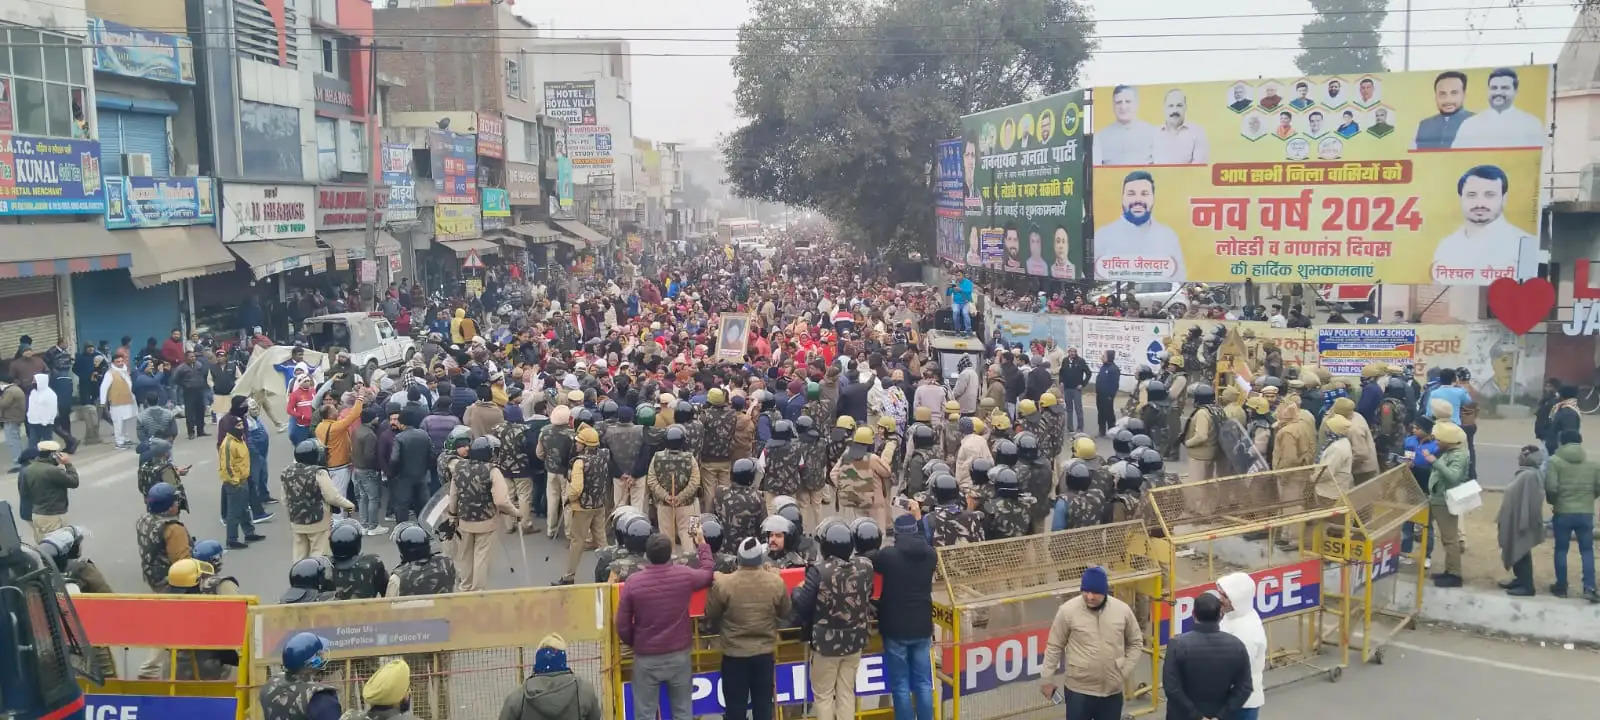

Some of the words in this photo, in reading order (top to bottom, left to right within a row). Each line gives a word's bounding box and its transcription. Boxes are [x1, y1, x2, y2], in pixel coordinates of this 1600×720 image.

[556, 89, 584, 98] HOTEL
[546, 99, 571, 108] ROYAL
[573, 99, 595, 108] VILLA
[480, 119, 502, 136] HOTEL
[980, 152, 1019, 170] जननायक
[1020, 148, 1049, 166] जनता
[1051, 139, 1078, 163] पार्टी
[16, 159, 59, 184] KUNAL
[1220, 169, 1247, 183] आप
[1251, 166, 1283, 183] सभी
[1286, 164, 1324, 182] जिला
[1328, 162, 1379, 182] वासियों
[1382, 163, 1404, 181] को
[32, 187, 62, 196] MERCHANT
[1063, 177, 1074, 196] की
[1190, 197, 1250, 231] नव
[1258, 189, 1314, 231] वर्ष
[1321, 196, 1423, 231] 2024
[1268, 241, 1281, 257] व
[1284, 237, 1342, 257] गणतंत्र
[1346, 236, 1393, 258] दिवस
[1103, 256, 1130, 270] शक्ति
[1231, 260, 1248, 276] की
[1252, 260, 1294, 277] हार्दिक
[1436, 265, 1475, 281] निश्चल
[1562, 302, 1600, 337] JA
[1320, 329, 1333, 337] DAV
[1334, 329, 1359, 337] POLICE
[1360, 329, 1386, 337] PUBLIC
[1387, 329, 1414, 337] SCHOOL
[336, 626, 361, 636] Follow
[328, 637, 374, 647] nagarPolice
